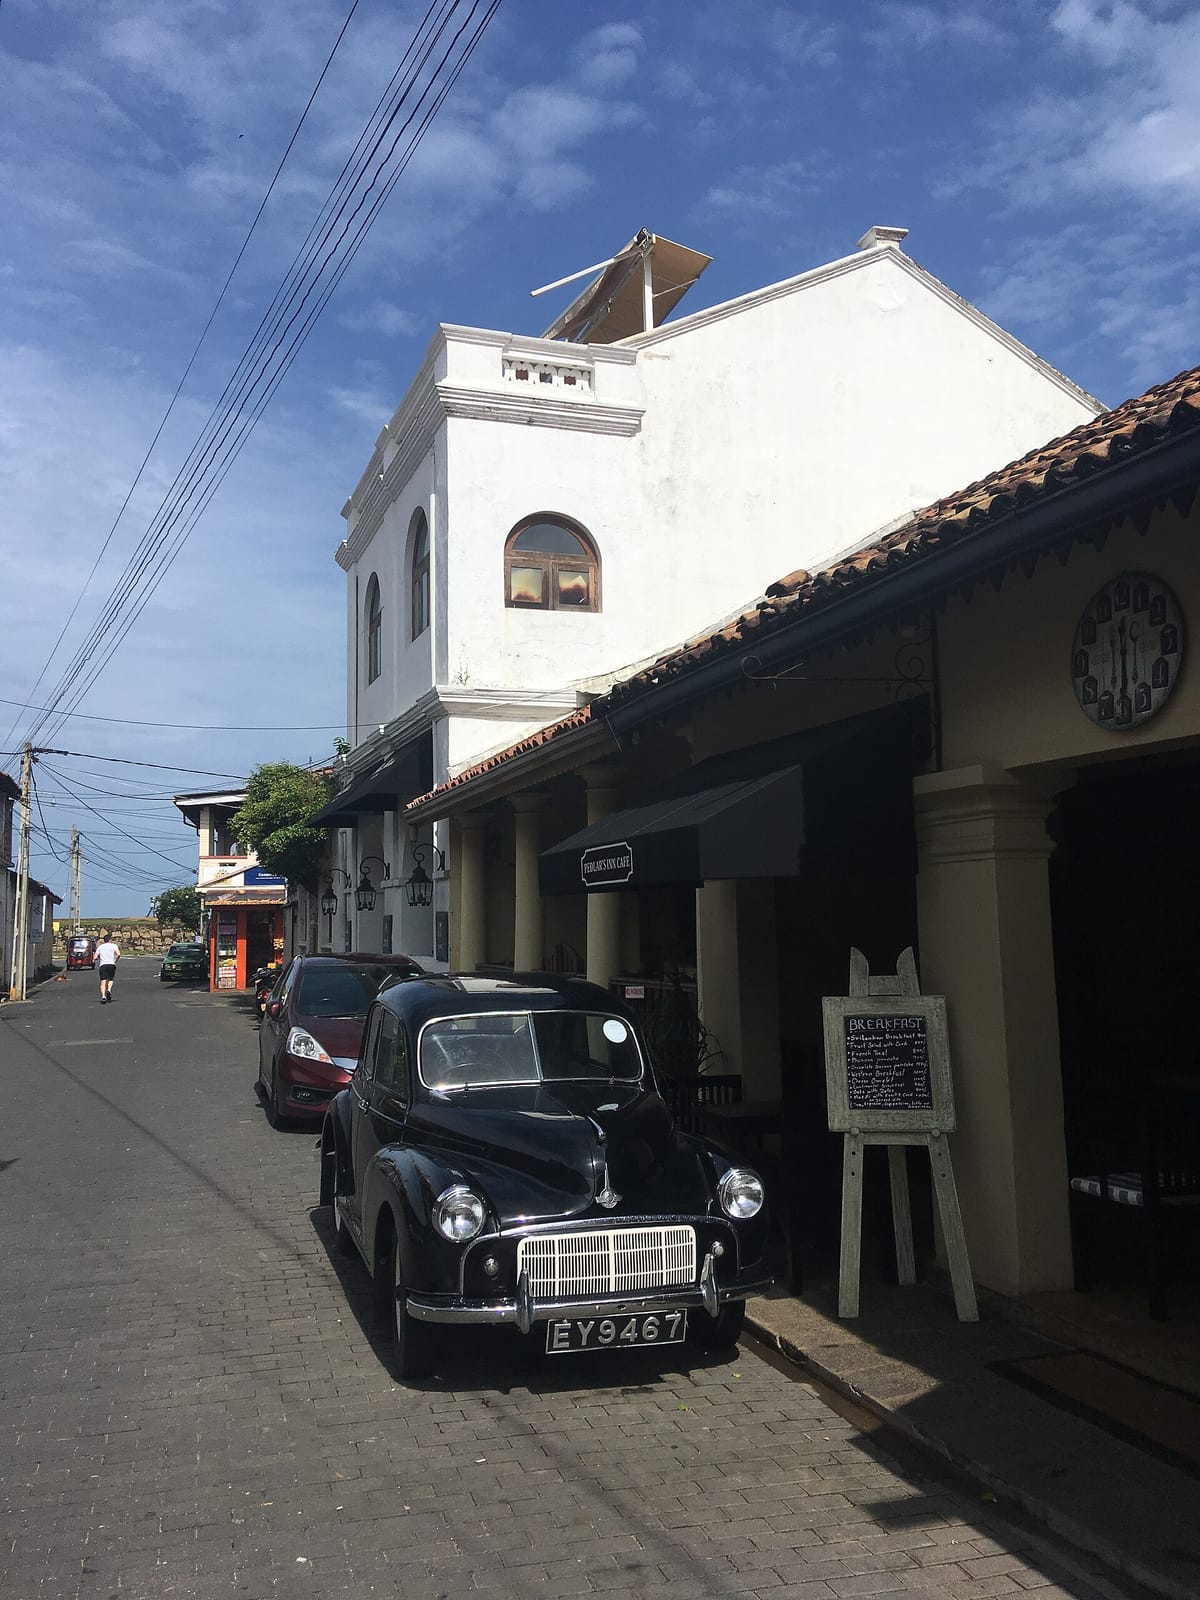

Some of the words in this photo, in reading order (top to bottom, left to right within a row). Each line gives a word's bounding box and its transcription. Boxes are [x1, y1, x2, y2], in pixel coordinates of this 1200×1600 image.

[617, 855, 630, 868] CAFE
[849, 1017, 922, 1030] BREAKFAST
[553, 1313, 681, 1349] EY9467
